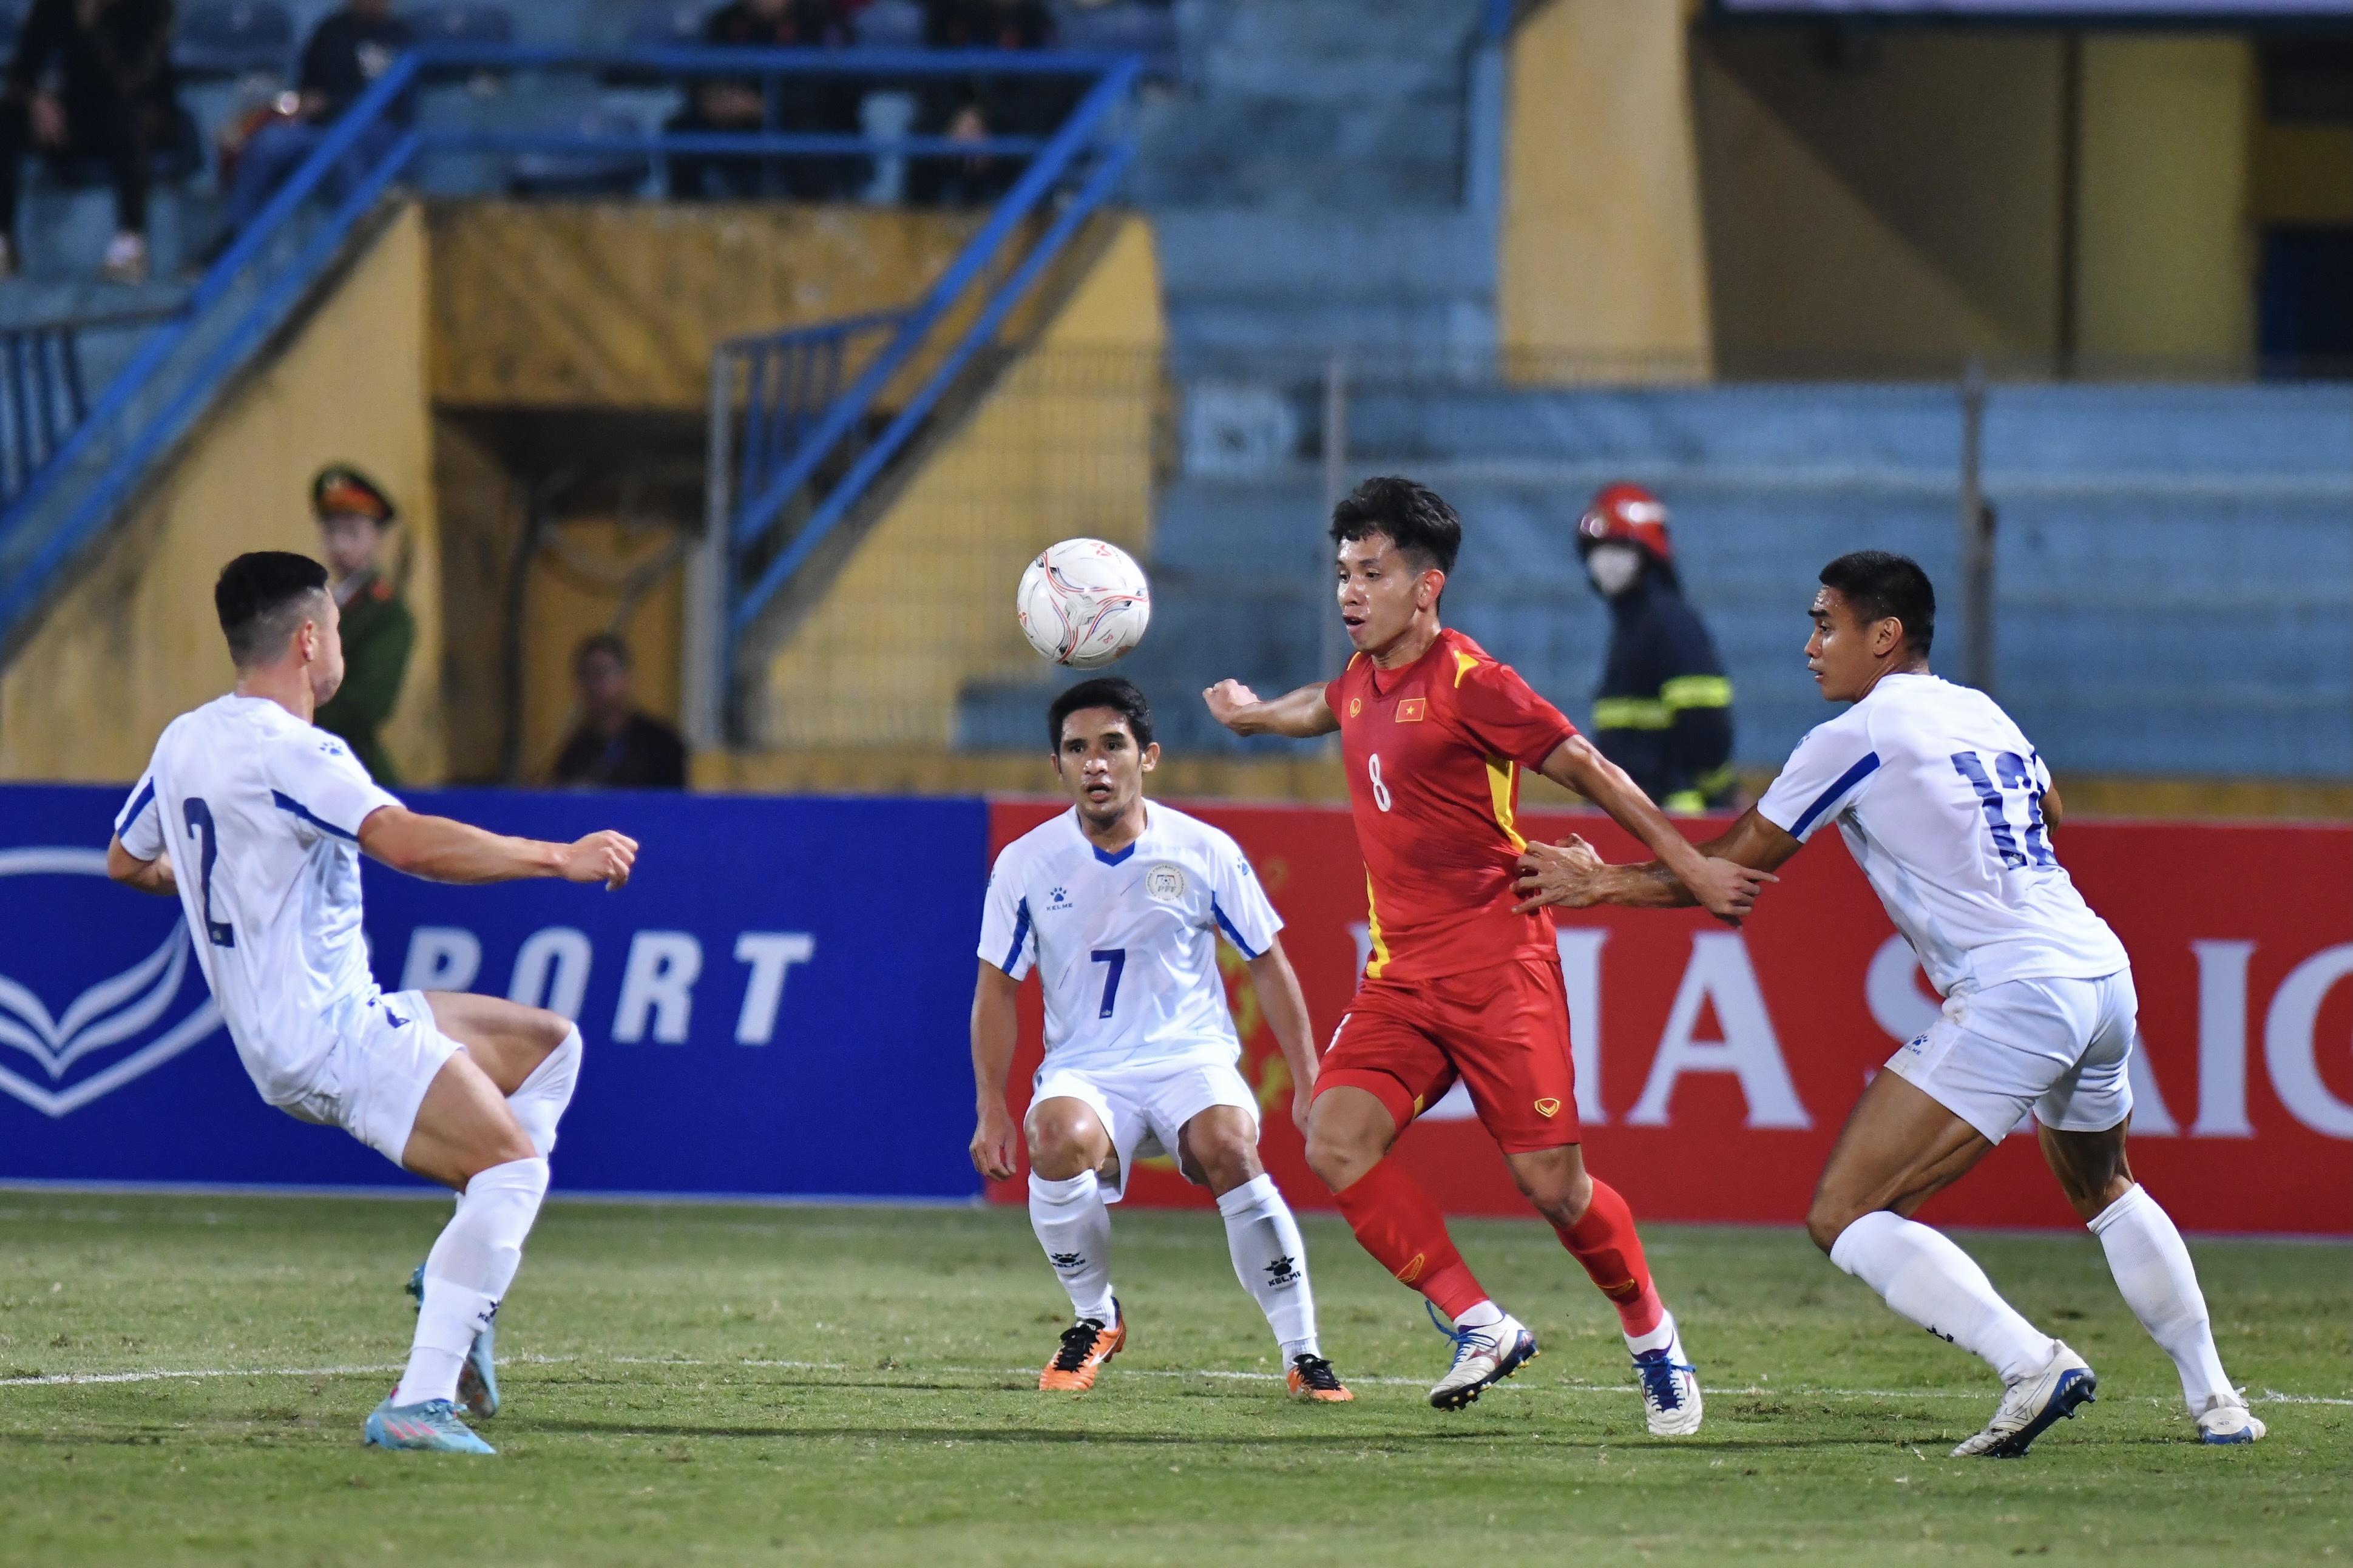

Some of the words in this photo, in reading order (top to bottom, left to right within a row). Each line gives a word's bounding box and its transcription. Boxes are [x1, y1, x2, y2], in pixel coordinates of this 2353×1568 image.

[1369, 753, 1391, 812] 8
[1950, 751, 2059, 870] 12
[183, 797, 235, 948] 2
[1046, 902, 1073, 911] KELME
[364, 925, 816, 1044] PORT
[1091, 949, 1125, 1019] 7
[1268, 1271, 1301, 1286] KELME
